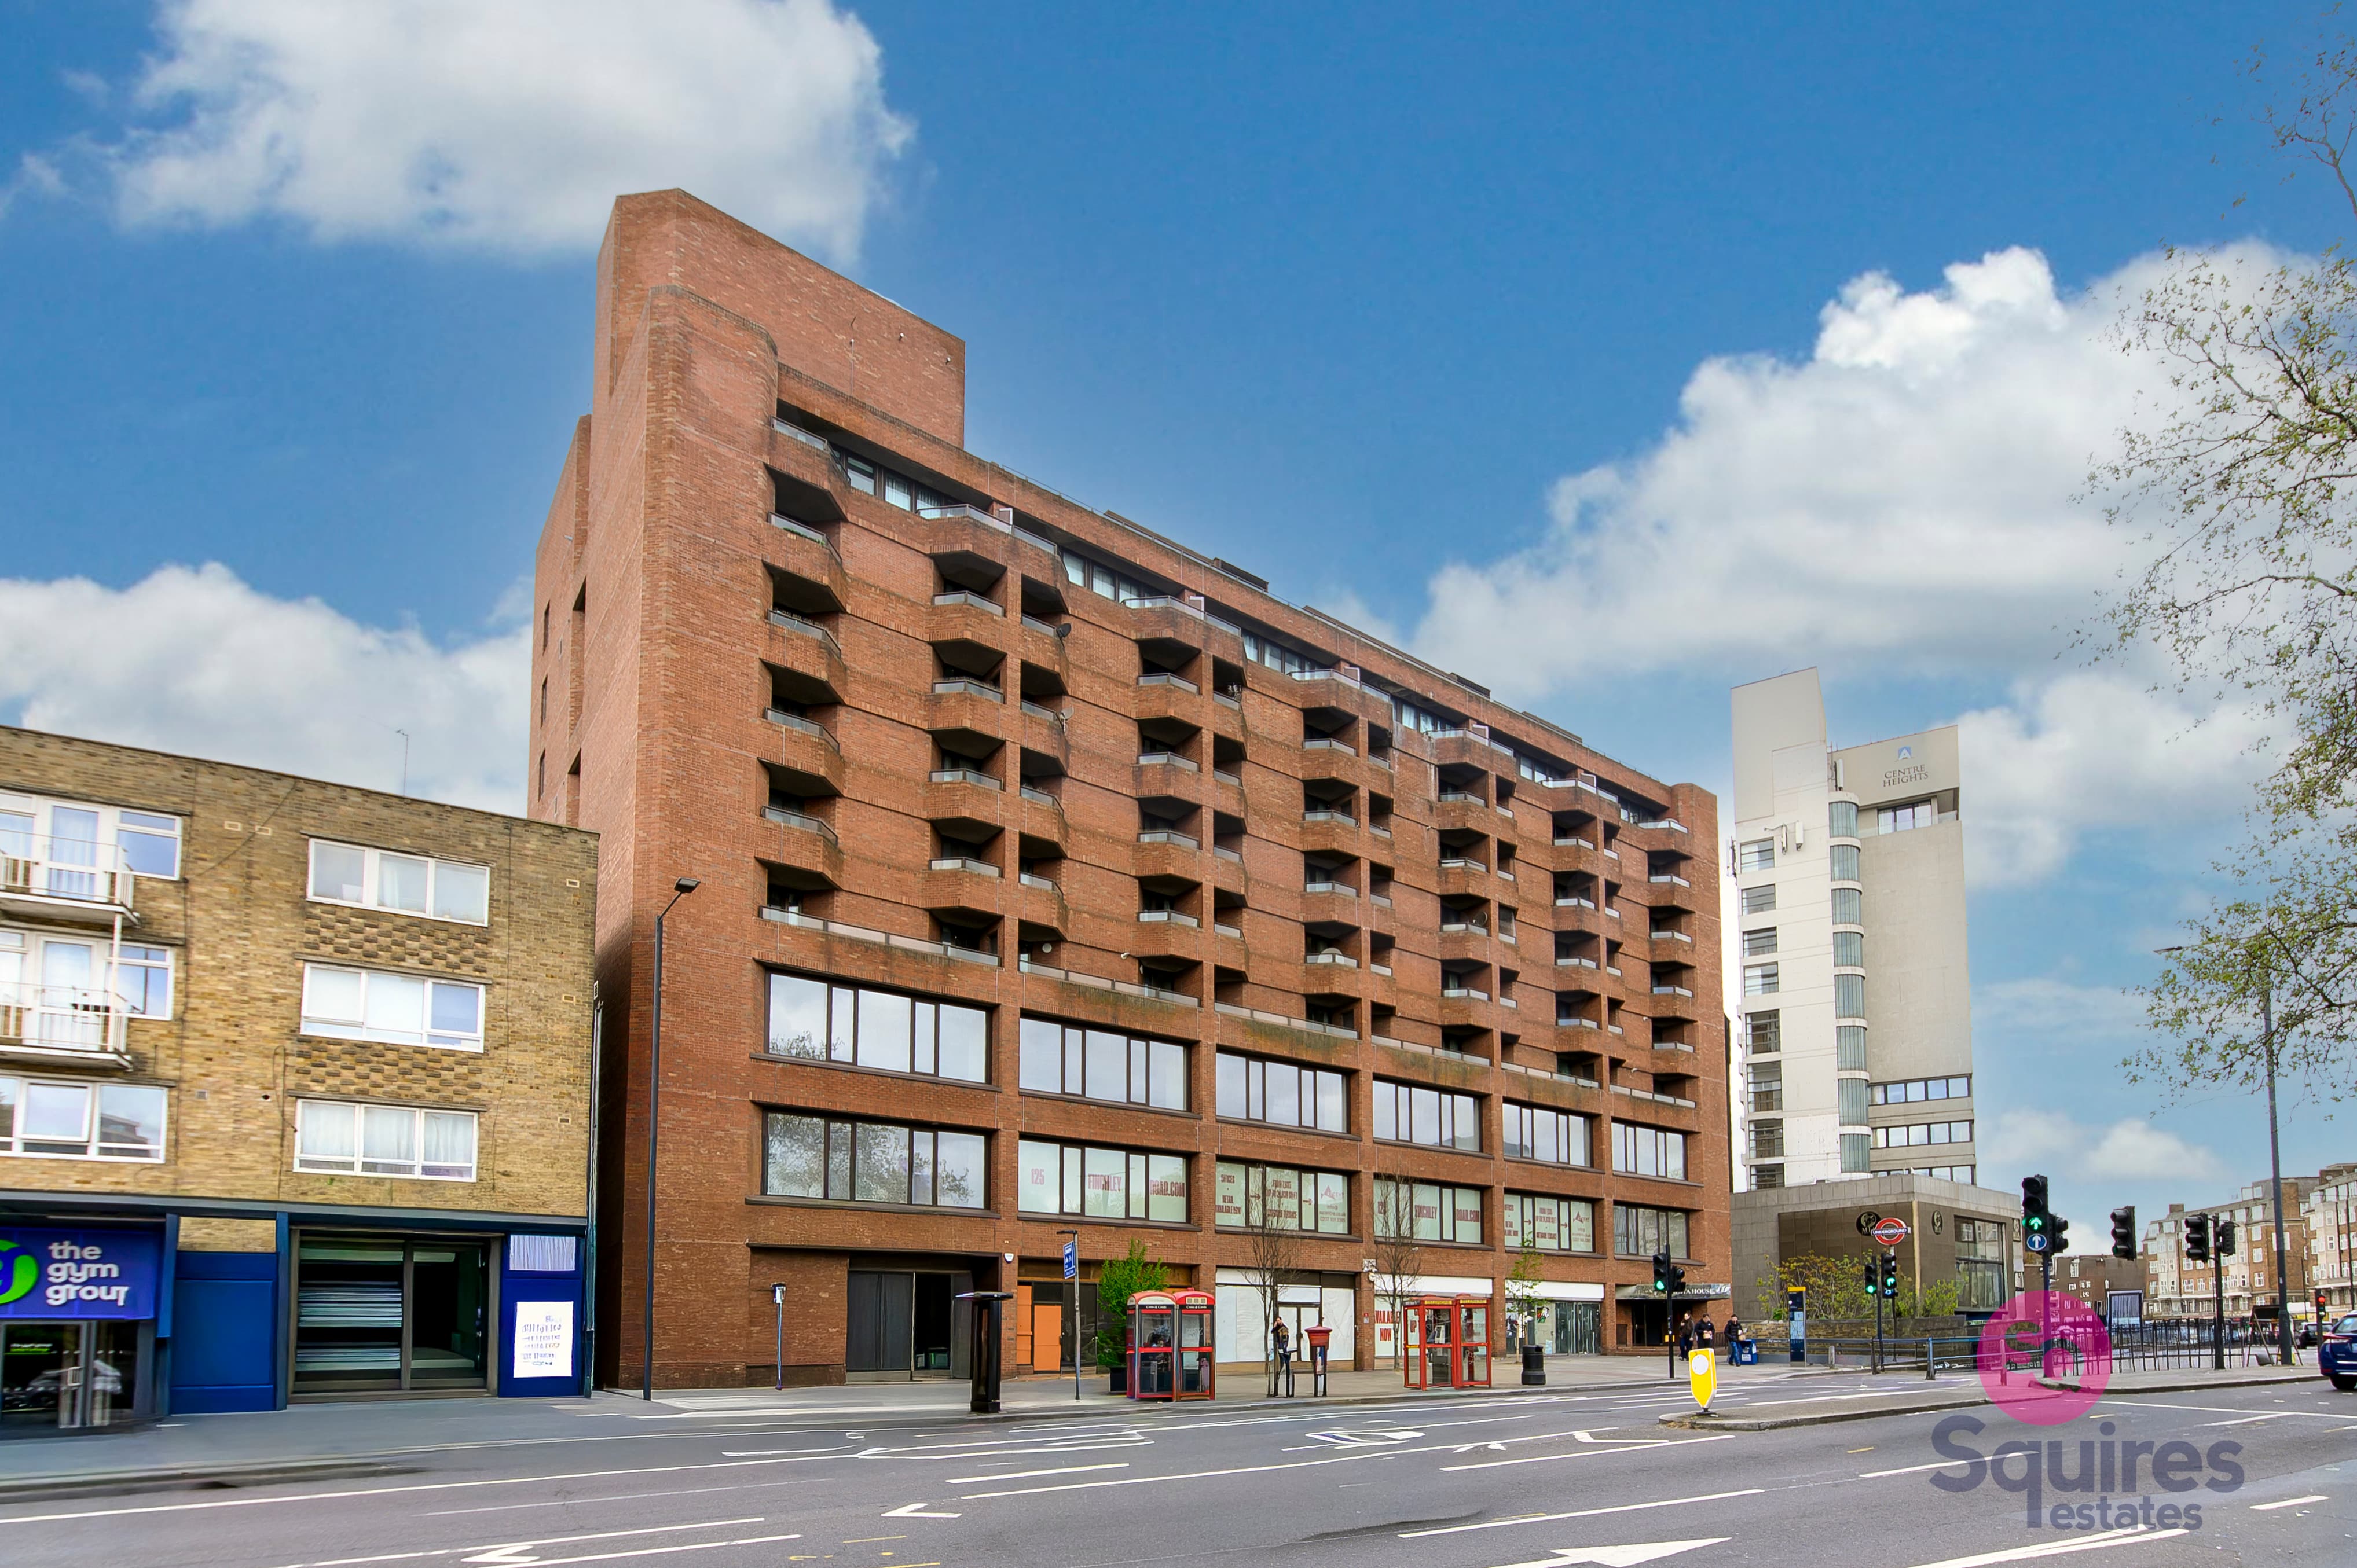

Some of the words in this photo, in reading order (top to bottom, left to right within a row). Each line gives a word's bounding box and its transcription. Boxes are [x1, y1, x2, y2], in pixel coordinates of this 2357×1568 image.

[1883, 772, 1929, 787] HEIGHTS
[1885, 764, 1925, 779] CENTRE
[1031, 1168, 1045, 1185] 125
[1088, 1173, 1122, 1192] FINCHLEY
[48, 1240, 102, 1260] the
[47, 1262, 119, 1283] gym
[1380, 1328, 1391, 1341] NOW
